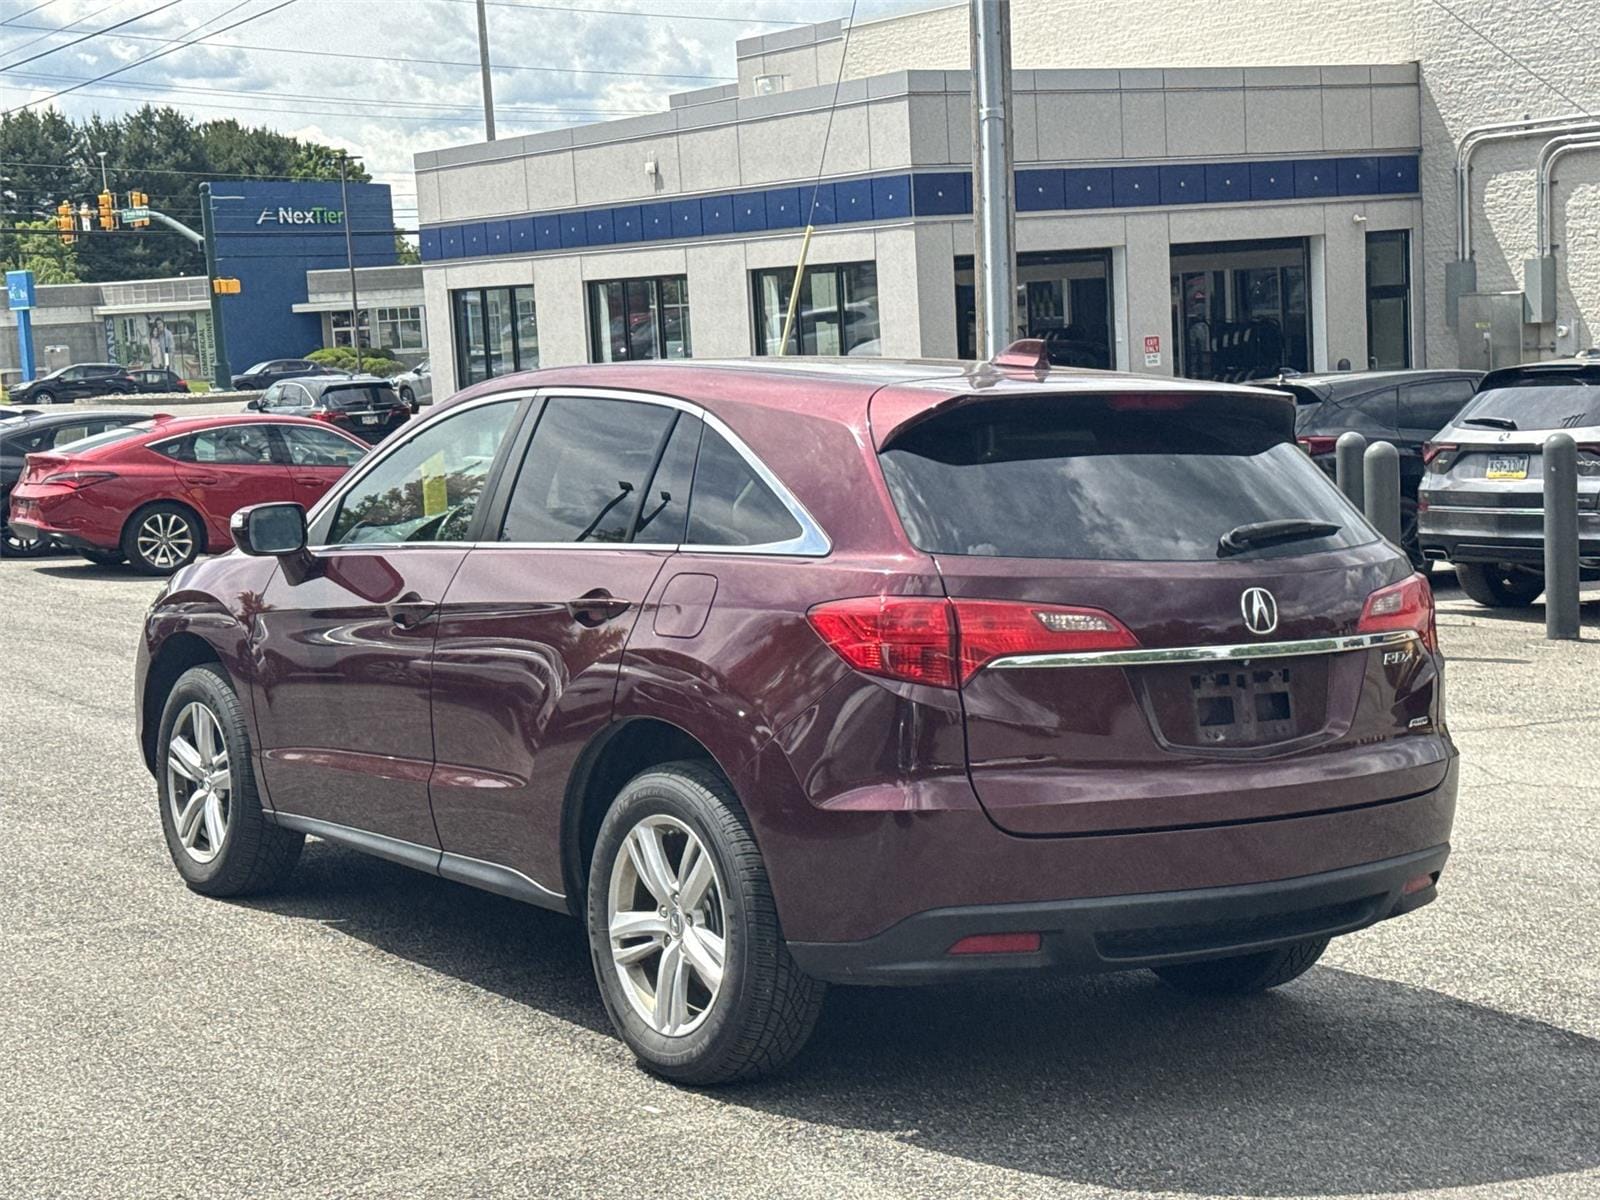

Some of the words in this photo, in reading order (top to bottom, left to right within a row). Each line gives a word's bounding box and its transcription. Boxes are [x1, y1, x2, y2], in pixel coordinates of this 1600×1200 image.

[278, 207, 344, 224] NexTier
[205, 310, 215, 349] BUSINESS
[199, 328, 209, 377] COMMERCIAL
